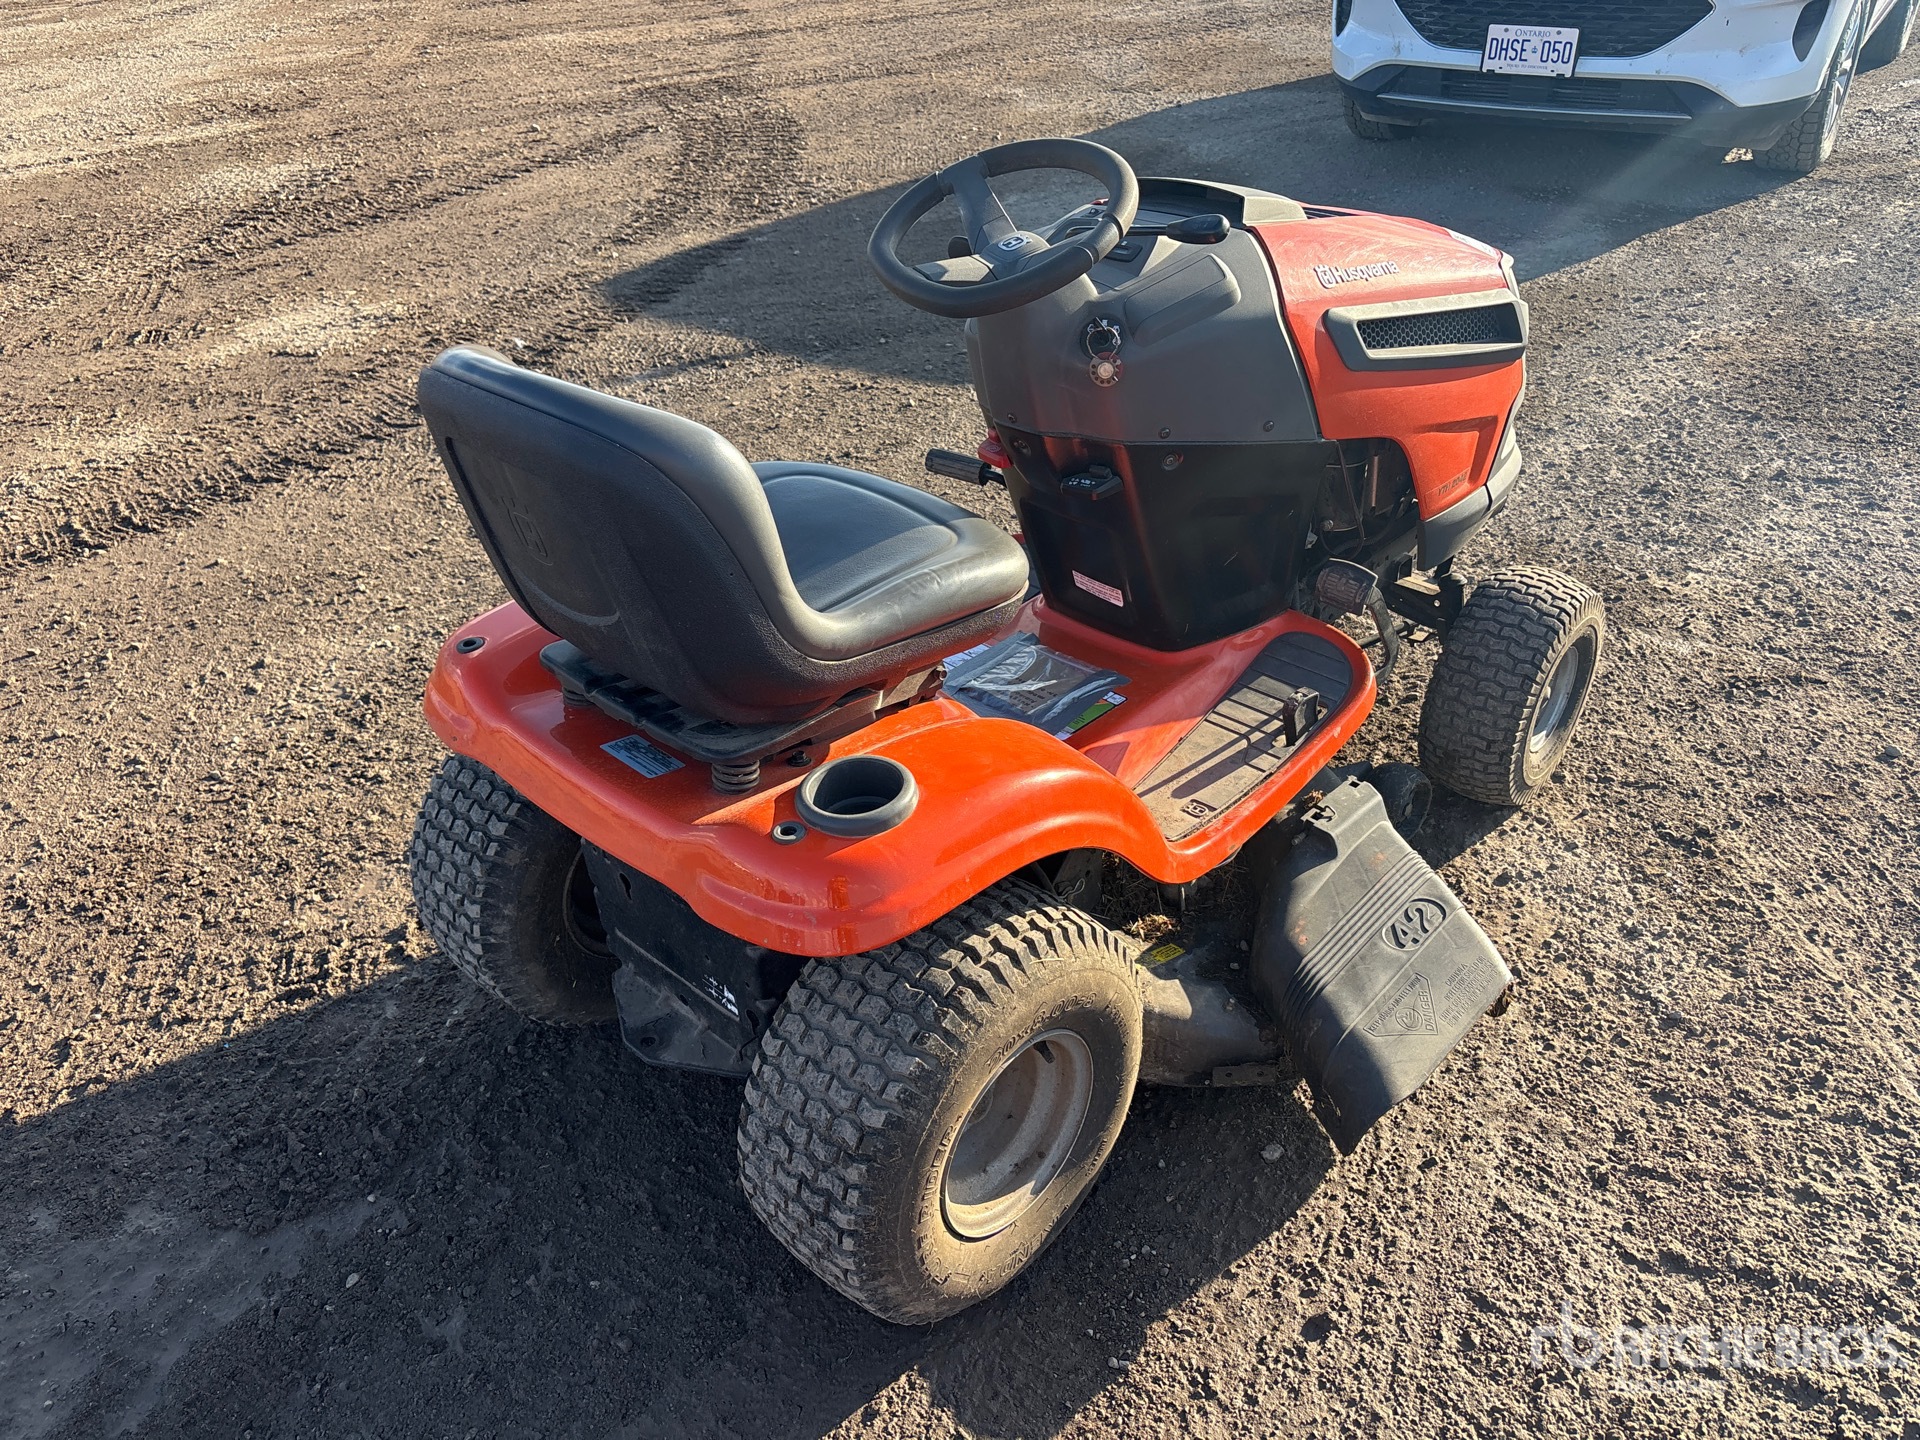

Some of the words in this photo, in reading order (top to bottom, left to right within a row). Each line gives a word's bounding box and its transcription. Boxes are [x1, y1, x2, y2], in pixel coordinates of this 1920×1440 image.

[1514, 28, 1551, 38] ONTARIO
[1488, 37, 1531, 62] DHSE
[1540, 40, 1573, 64] 050
[1331, 260, 1400, 284] Husqvarna
[1390, 900, 1435, 949] 42
[1418, 990, 1435, 1031] DANGER
[917, 1120, 957, 1224] RIDER
